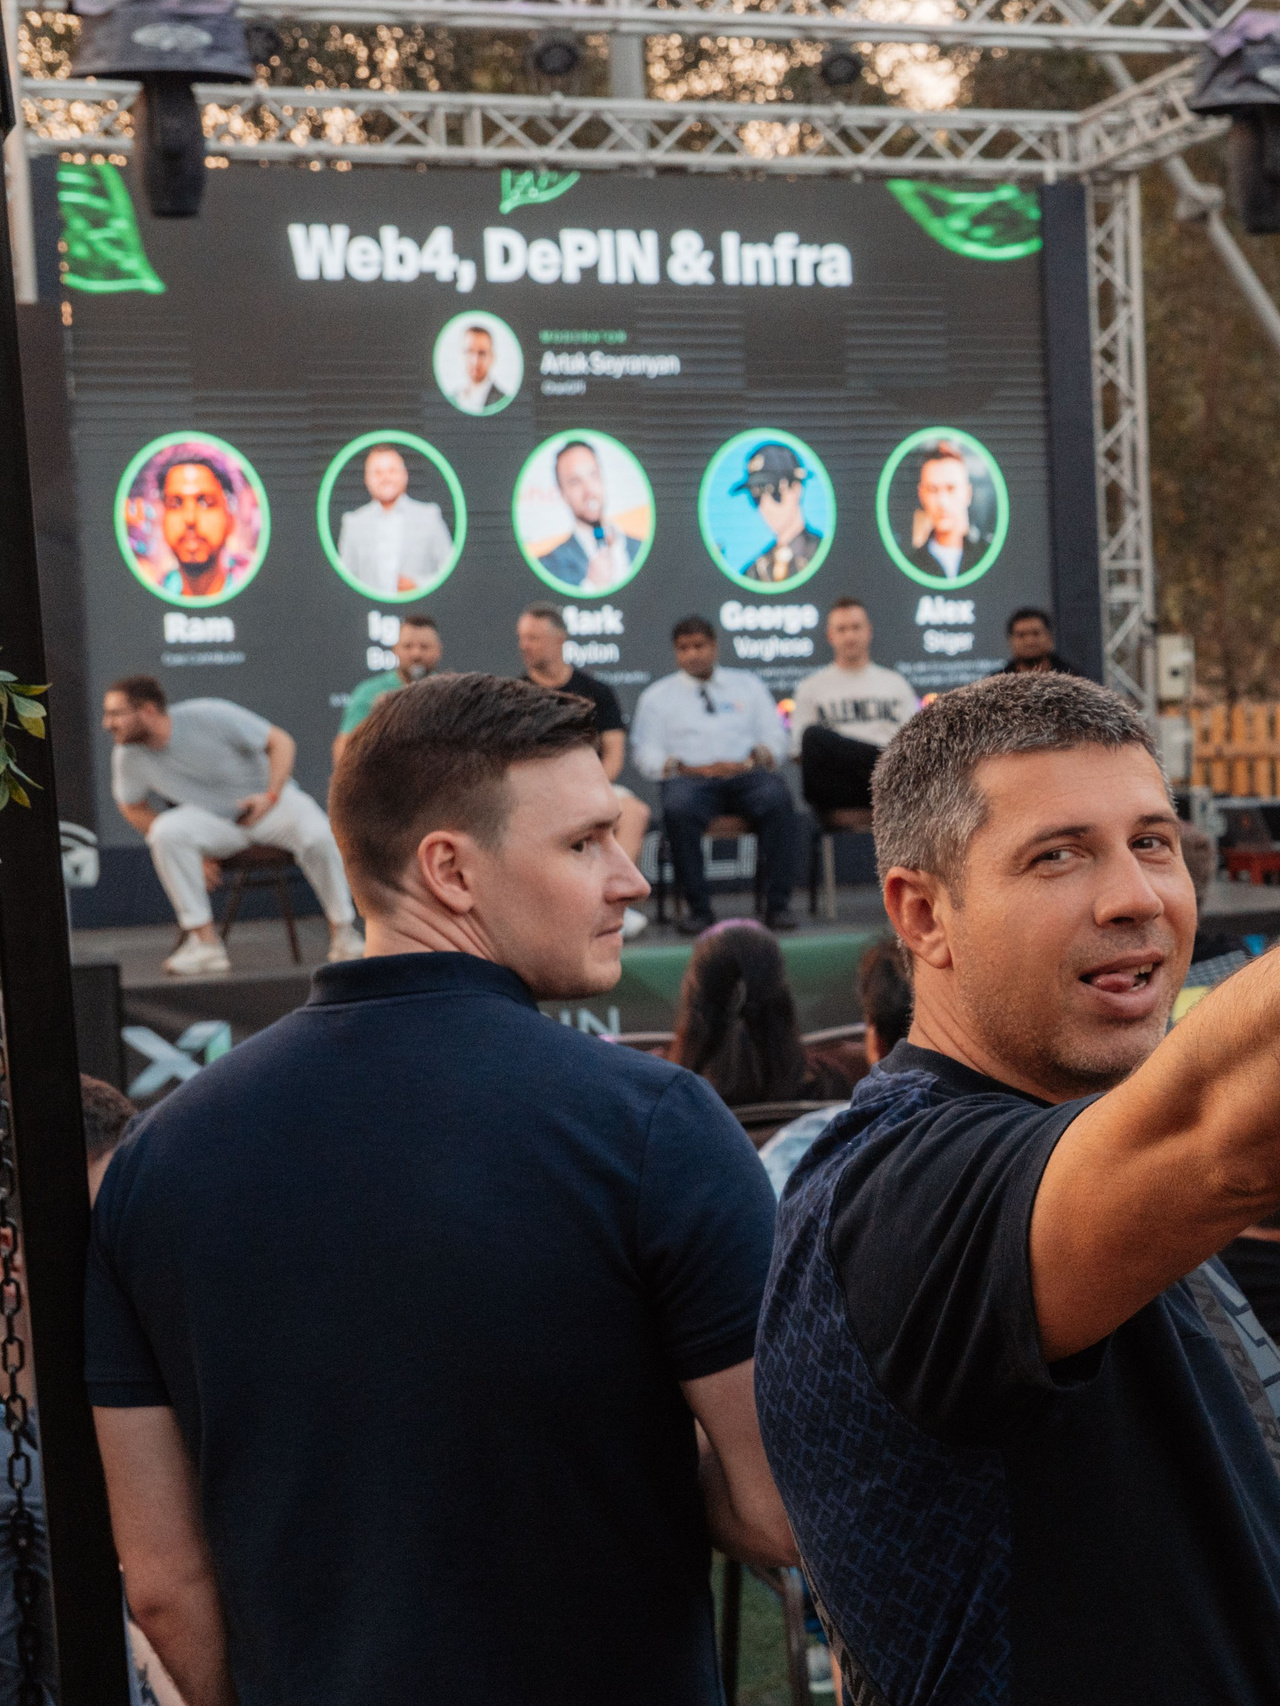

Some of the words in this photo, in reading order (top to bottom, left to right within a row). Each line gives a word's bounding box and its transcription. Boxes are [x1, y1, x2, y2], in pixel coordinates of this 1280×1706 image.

[287, 223, 477, 294] Web4,
[483, 226, 660, 285] DePIN
[667, 229, 715, 286] &
[720, 231, 853, 287] Infra
[164, 611, 236, 644] Ram
[719, 599, 820, 635] George
[915, 595, 976, 626] Alex
